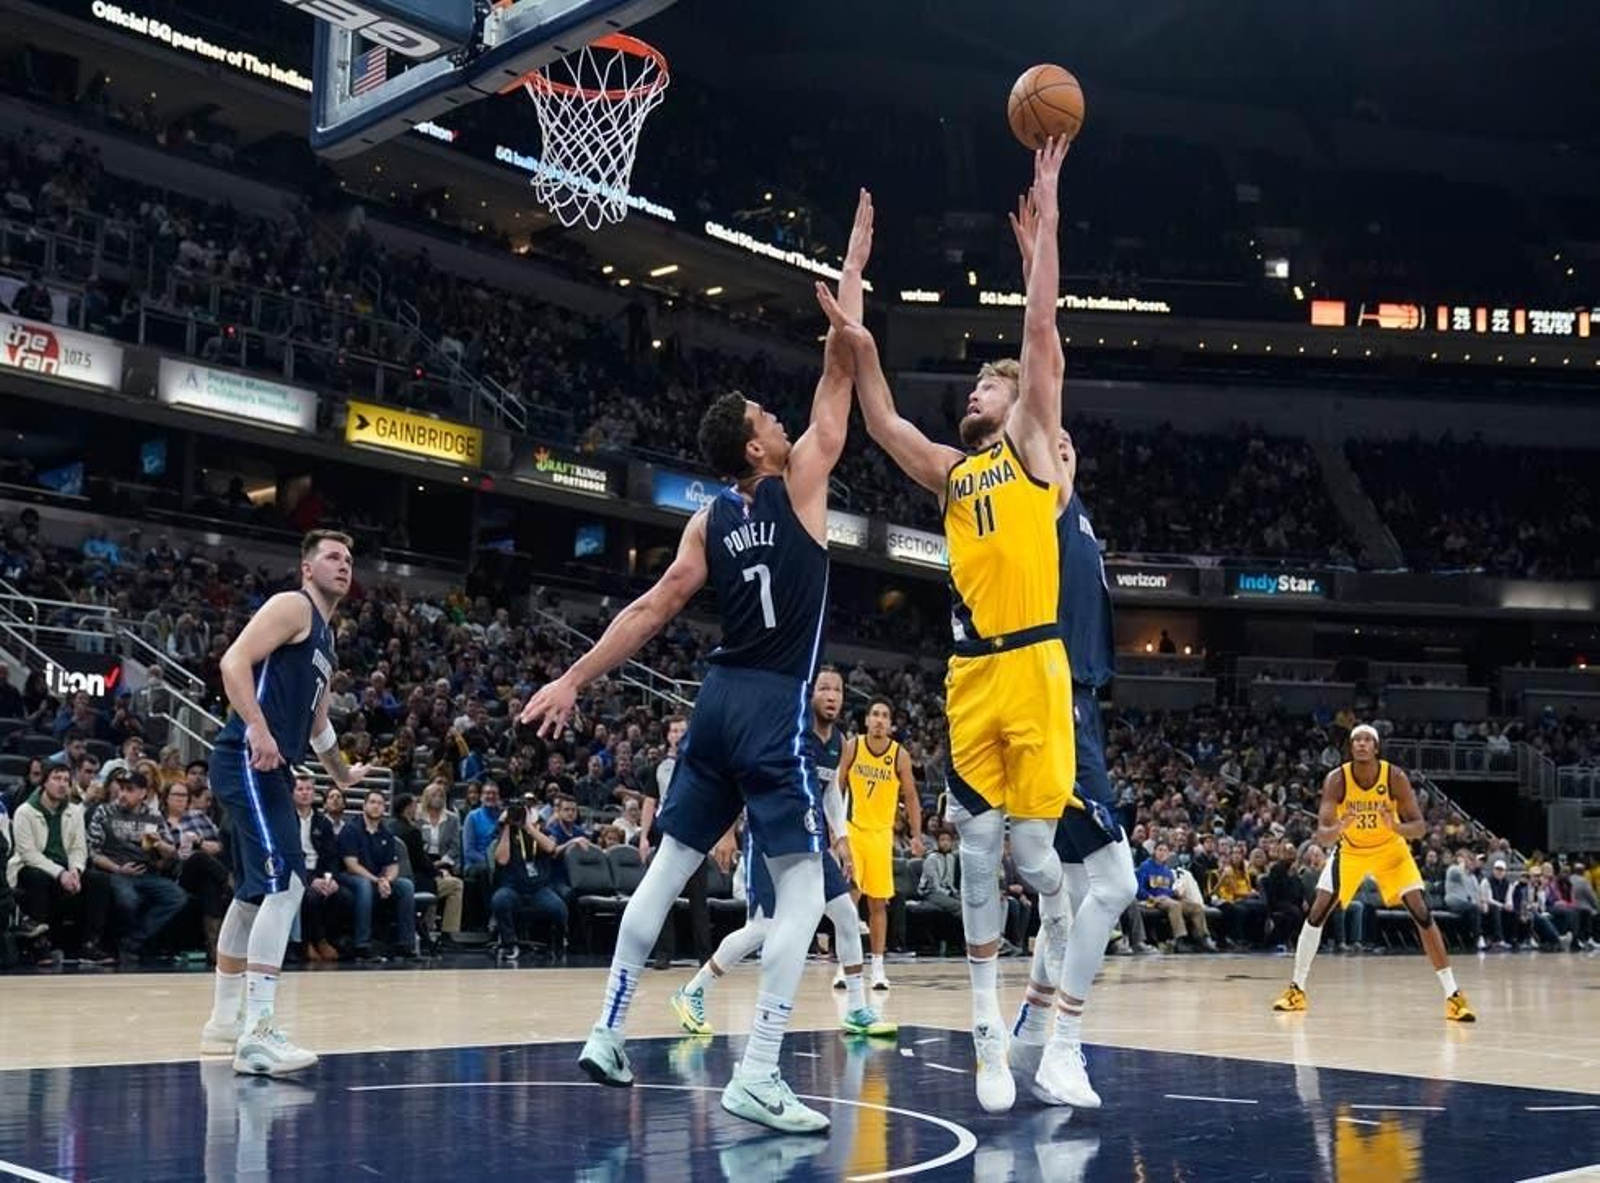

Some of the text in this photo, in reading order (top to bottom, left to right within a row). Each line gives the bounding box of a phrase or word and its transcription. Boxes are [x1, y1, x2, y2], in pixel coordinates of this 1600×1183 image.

[92, 0, 148, 34] Official
[149, 20, 172, 42] 5G
[172, 31, 227, 61] partner
[227, 52, 243, 67] of
[243, 53, 271, 77] The
[901, 288, 940, 302] verizon
[1087, 296, 1128, 311] Indiana
[1128, 298, 1170, 313] Pacers.
[5, 322, 49, 351] the
[375, 416, 476, 457] GAINBRIDGE
[975, 495, 995, 537] 11
[723, 521, 776, 558] POWELL
[889, 533, 941, 556] SECTION
[1117, 573, 1167, 588] verizon
[742, 564, 776, 629] 7
[867, 780, 876, 799] 7
[1356, 813, 1378, 830] 33
